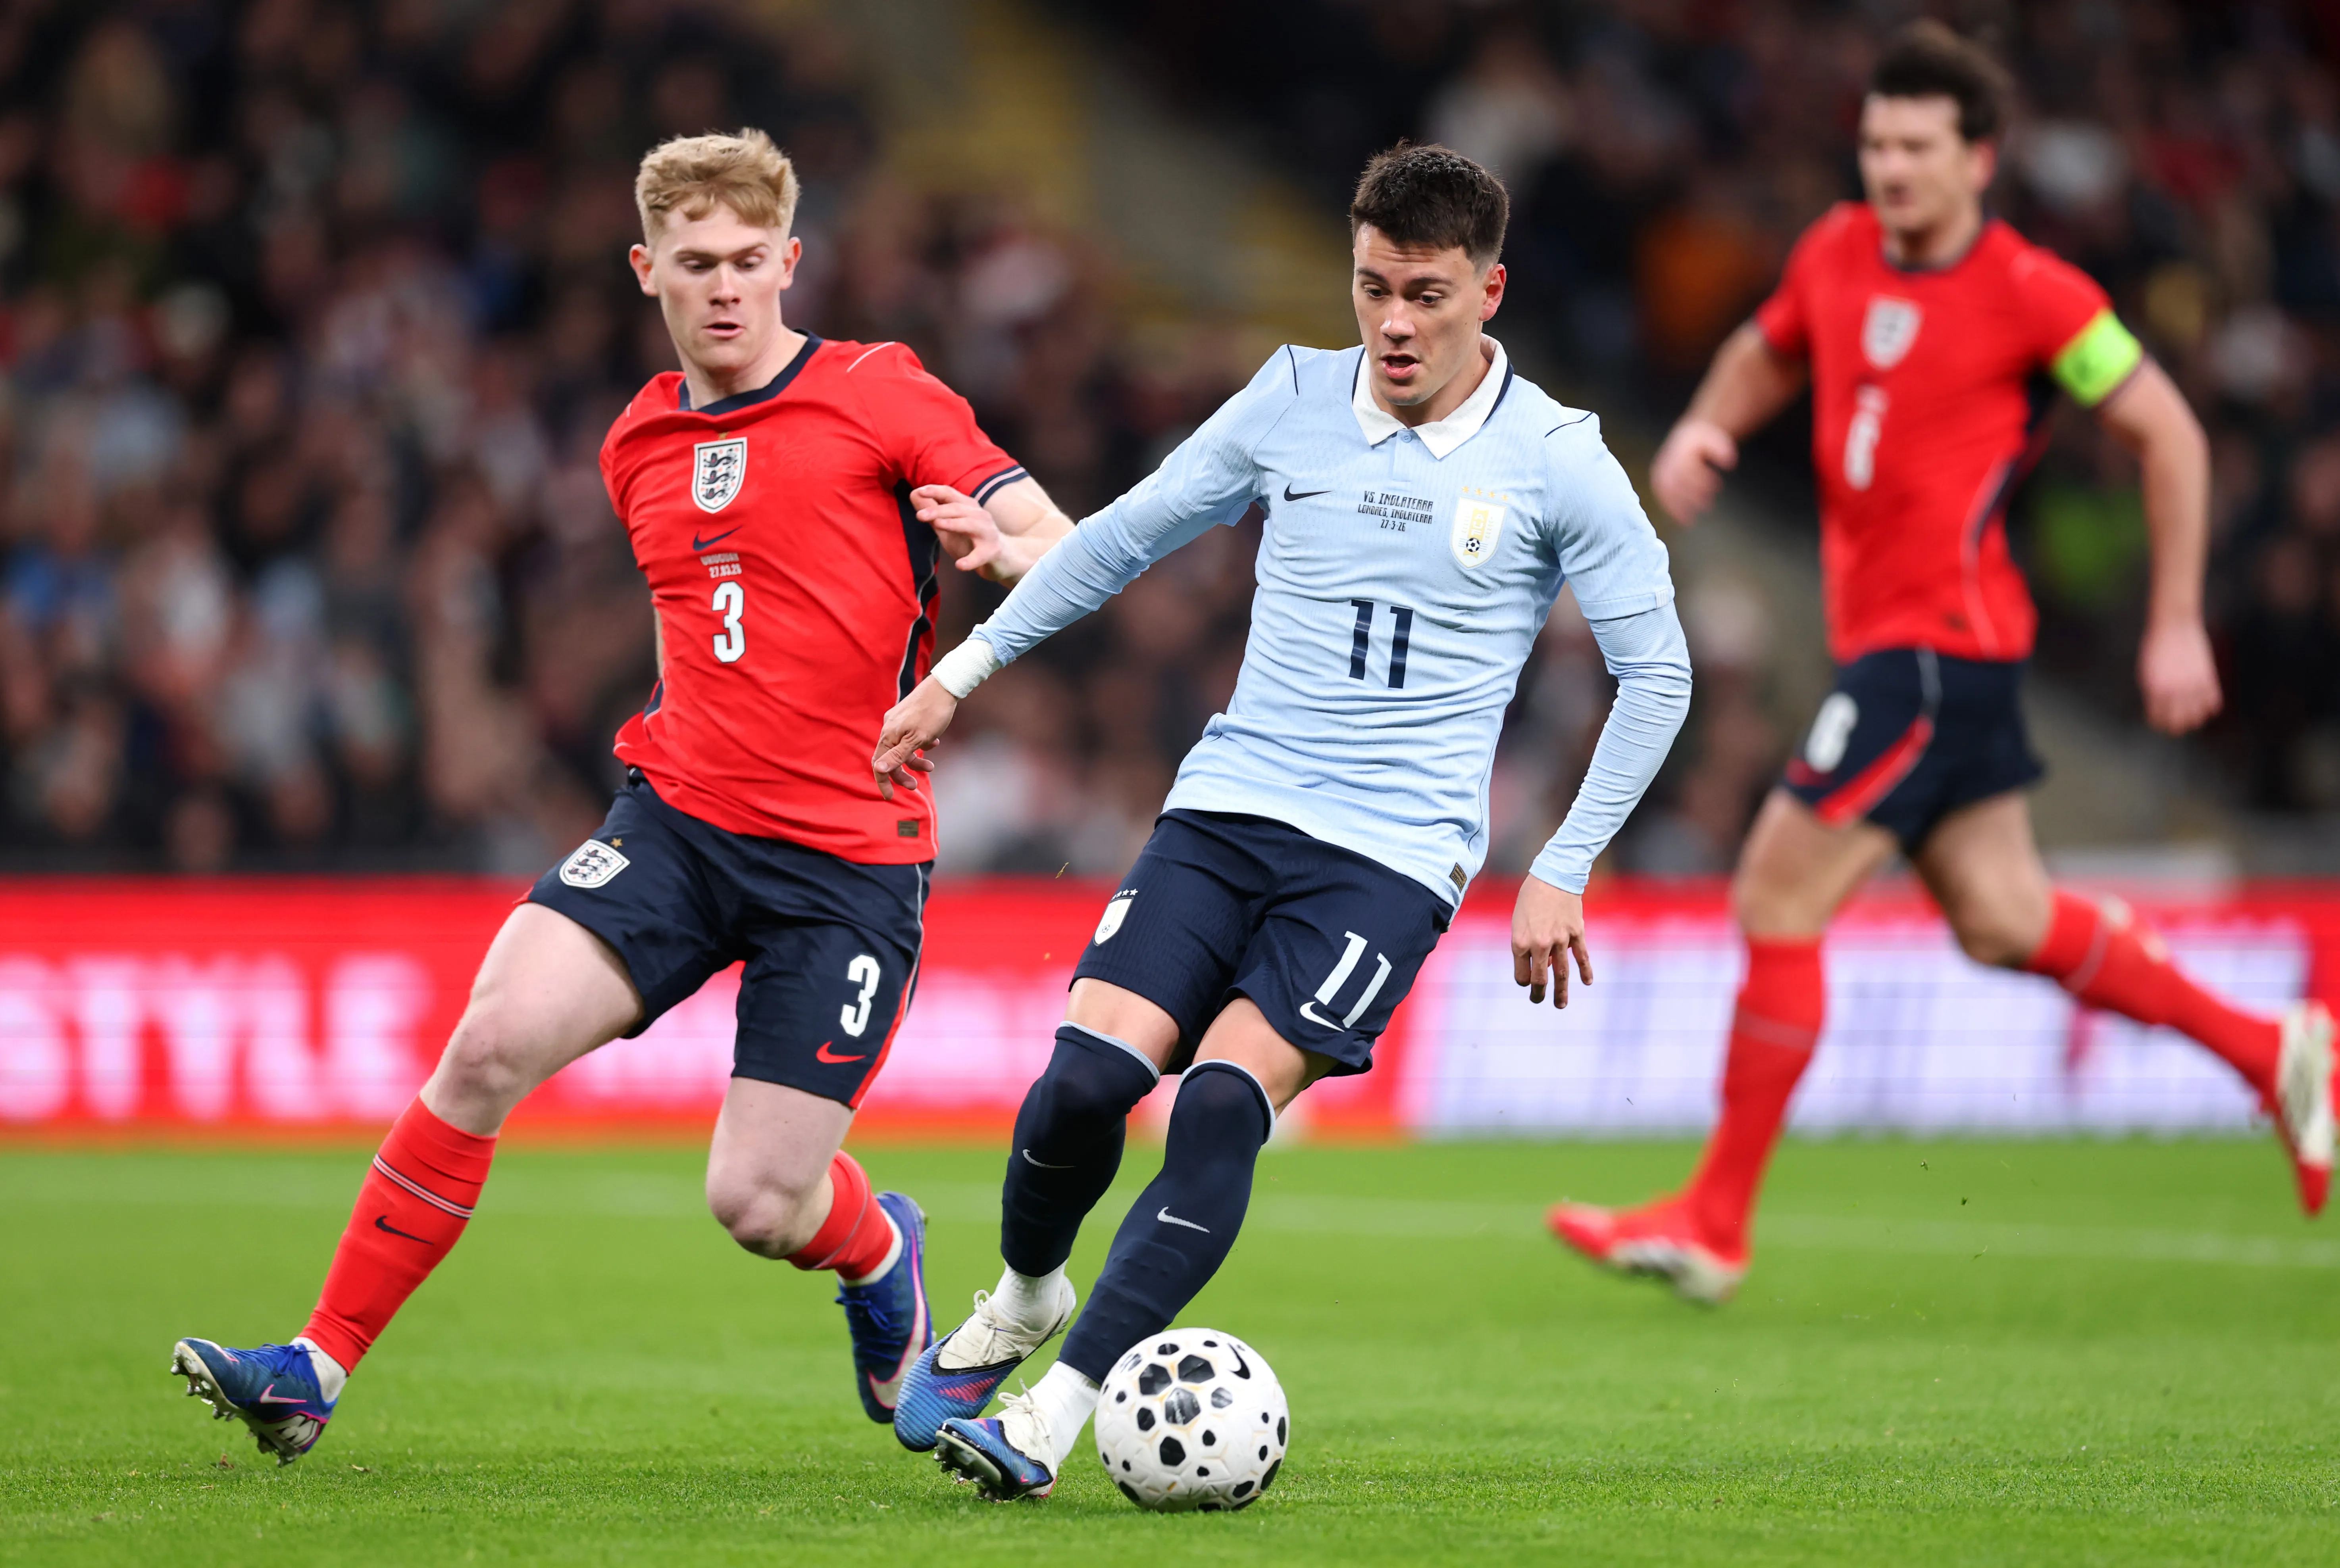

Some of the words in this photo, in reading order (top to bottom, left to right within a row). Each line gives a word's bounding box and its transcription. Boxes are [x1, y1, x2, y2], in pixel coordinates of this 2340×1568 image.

[1358, 504, 1388, 518] LONDRES,
[1391, 509, 1433, 524] INGLATERRA
[1364, 490, 1375, 503] VS.
[1378, 493, 1434, 512] INGLATERRA
[712, 581, 745, 663] 3
[1349, 600, 1413, 689] 11
[840, 955, 880, 1037] 3
[1314, 930, 1392, 1028] 11
